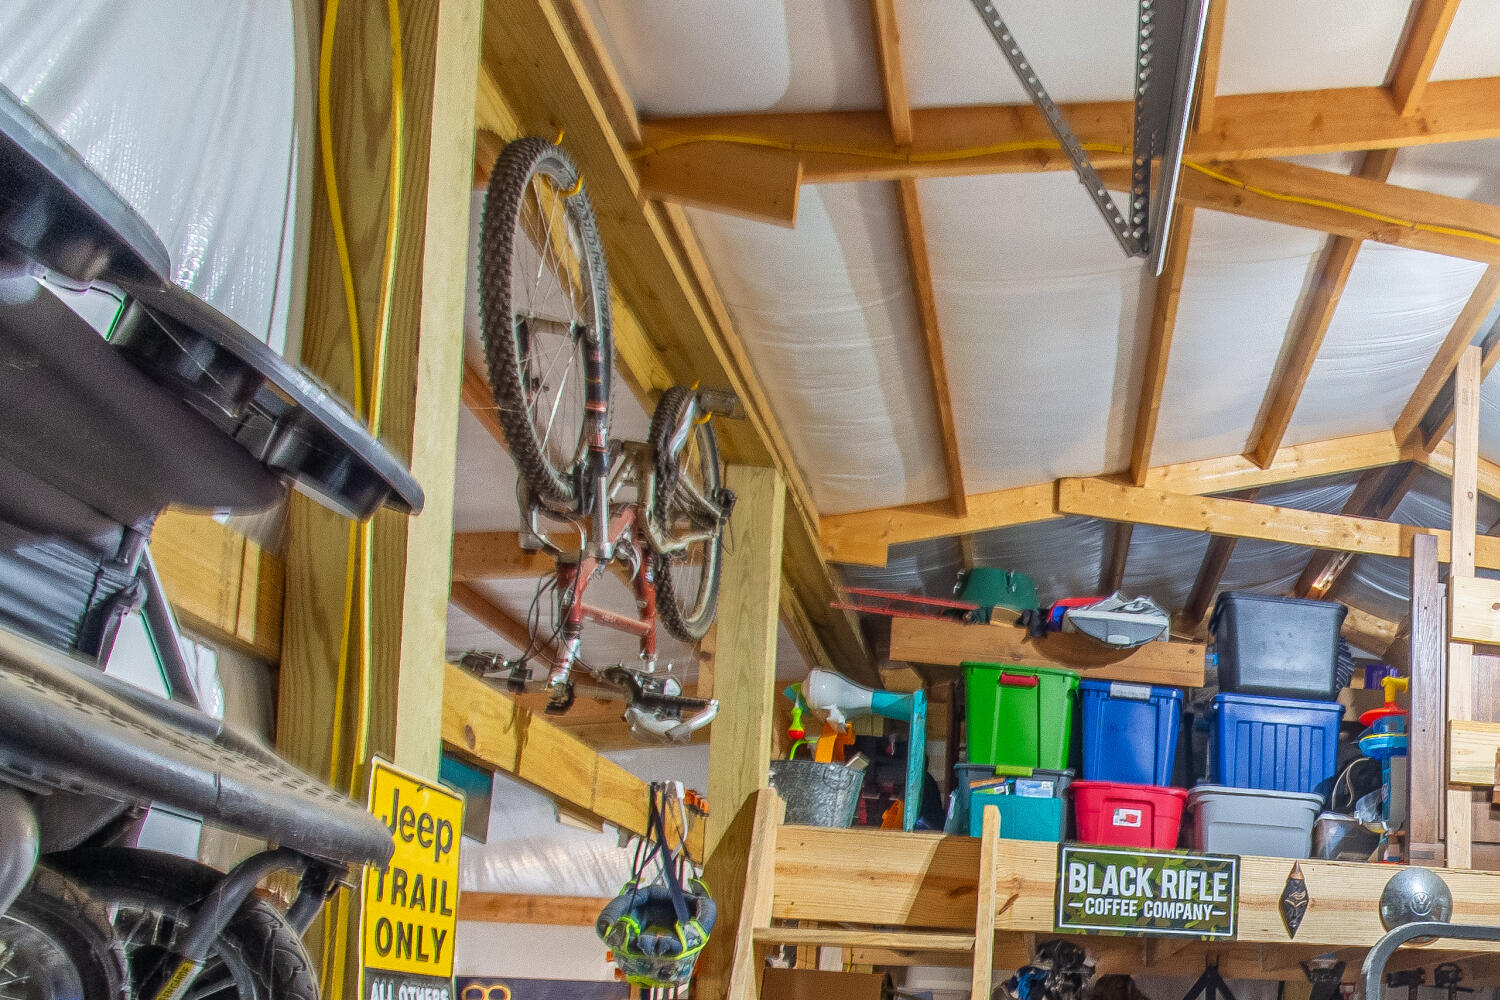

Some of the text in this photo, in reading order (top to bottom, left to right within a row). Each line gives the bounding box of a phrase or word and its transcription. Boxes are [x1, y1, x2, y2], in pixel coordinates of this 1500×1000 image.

[382, 788, 453, 863] Jeep
[374, 865, 453, 917] TRAIL
[1068, 862, 1229, 902] BLACK RIFLE
[1085, 897, 1213, 921] COFFEE COMPANY
[374, 917, 448, 964] ONLY
